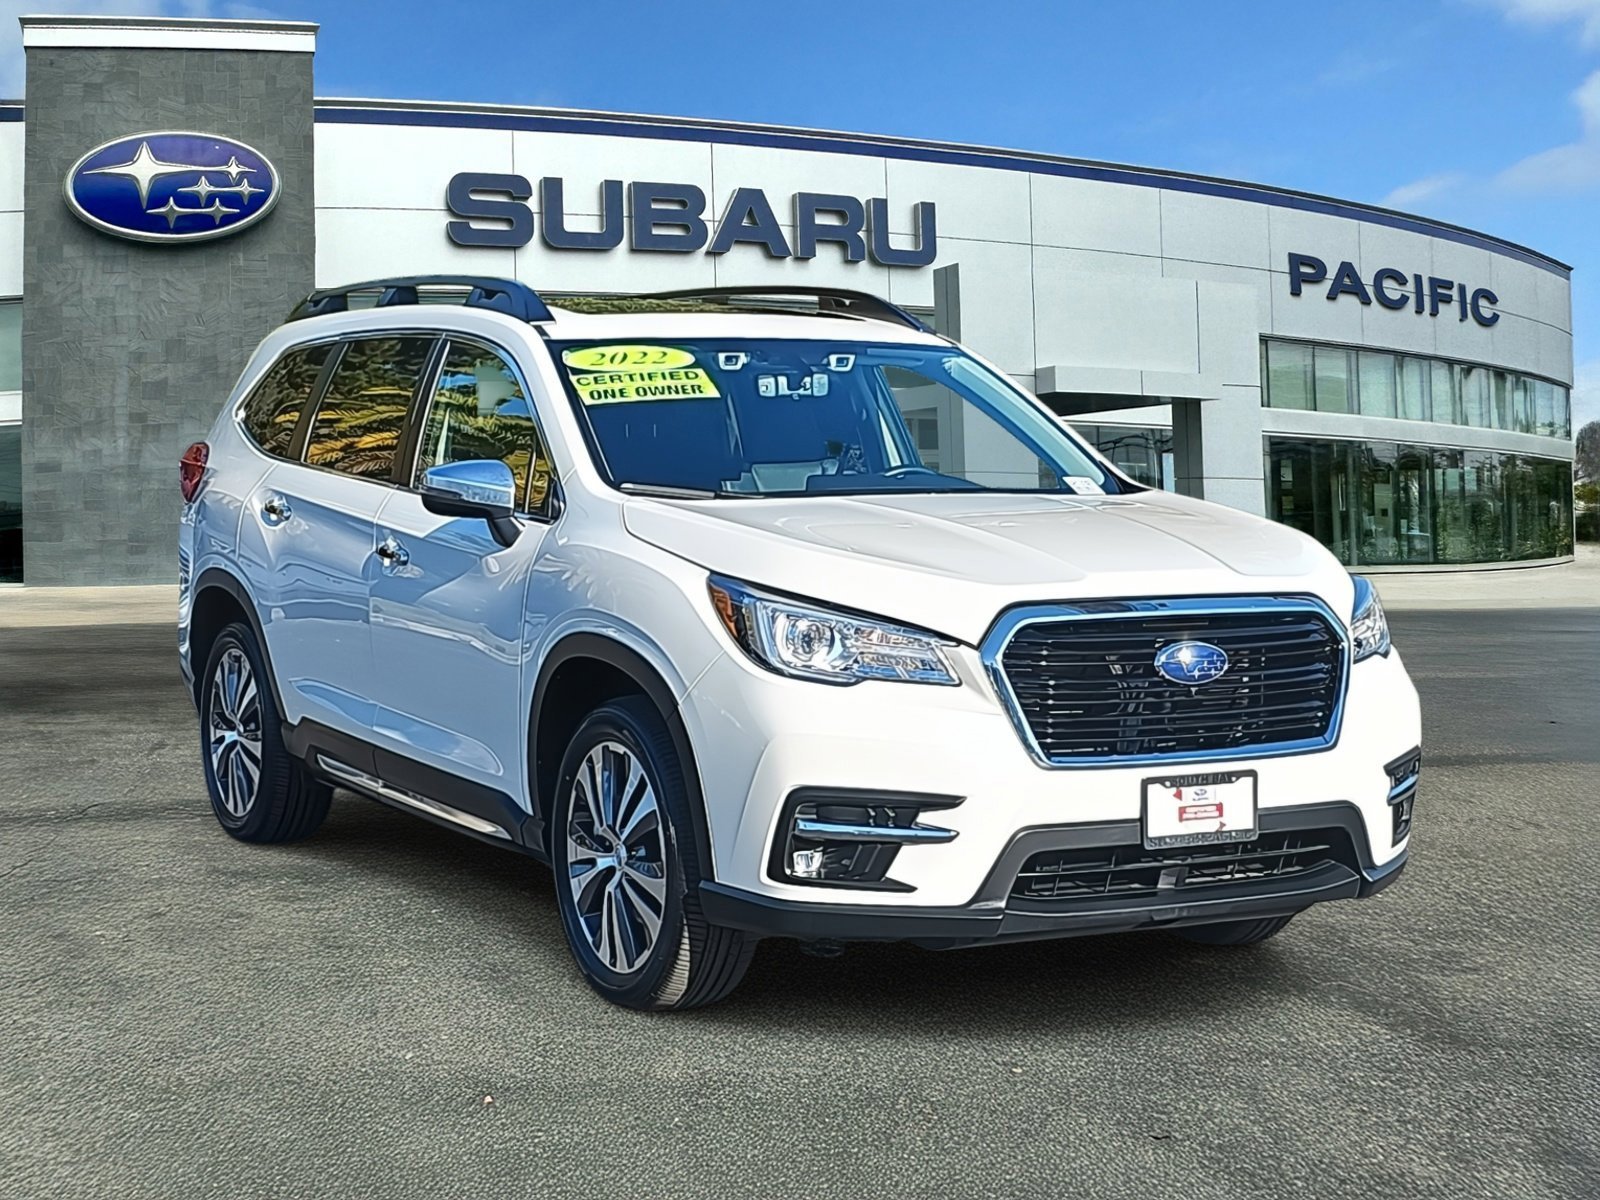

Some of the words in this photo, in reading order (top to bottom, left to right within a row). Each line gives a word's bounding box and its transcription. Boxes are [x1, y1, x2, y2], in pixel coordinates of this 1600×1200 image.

[446, 172, 936, 267] SUBARU
[1288, 252, 1501, 327] PACIFIC
[590, 351, 668, 366] 2022
[576, 370, 700, 387] CERTIFIED
[589, 387, 630, 401] ONE
[635, 384, 704, 398] OWNER
